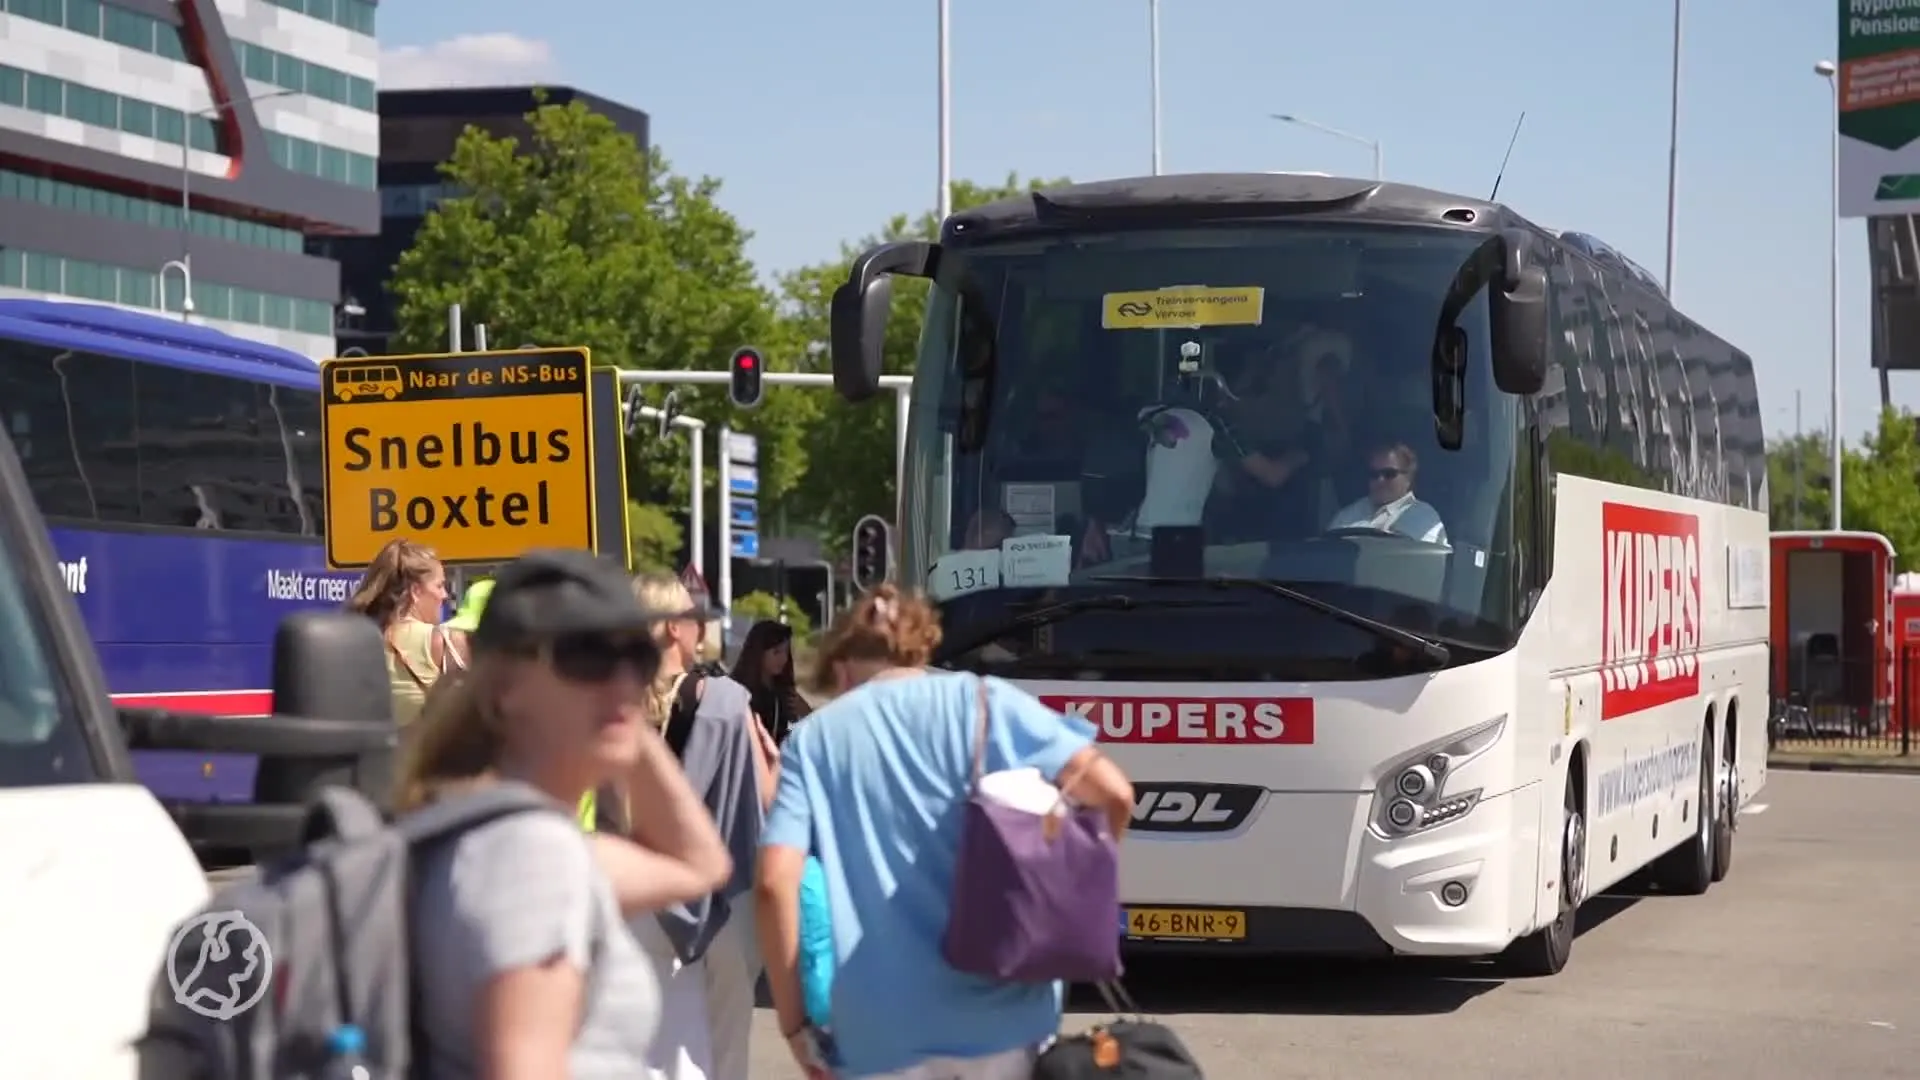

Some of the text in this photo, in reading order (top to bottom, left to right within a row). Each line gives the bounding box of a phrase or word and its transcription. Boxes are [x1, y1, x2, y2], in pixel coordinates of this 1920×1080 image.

[1155, 310, 1196, 320] Vervoer
[409, 364, 577, 388] Naar de NS-Bus
[344, 421, 570, 471] Snelbus
[369, 480, 549, 532] Boxtel
[268, 568, 303, 600] Maakt
[305, 577, 317, 600] er
[319, 578, 347, 602] meer
[952, 566, 987, 590] 131
[1606, 530, 1698, 692] KUPERS
[1064, 702, 1284, 739] KUPERS
[1133, 913, 1238, 934] 46-BNR-9
